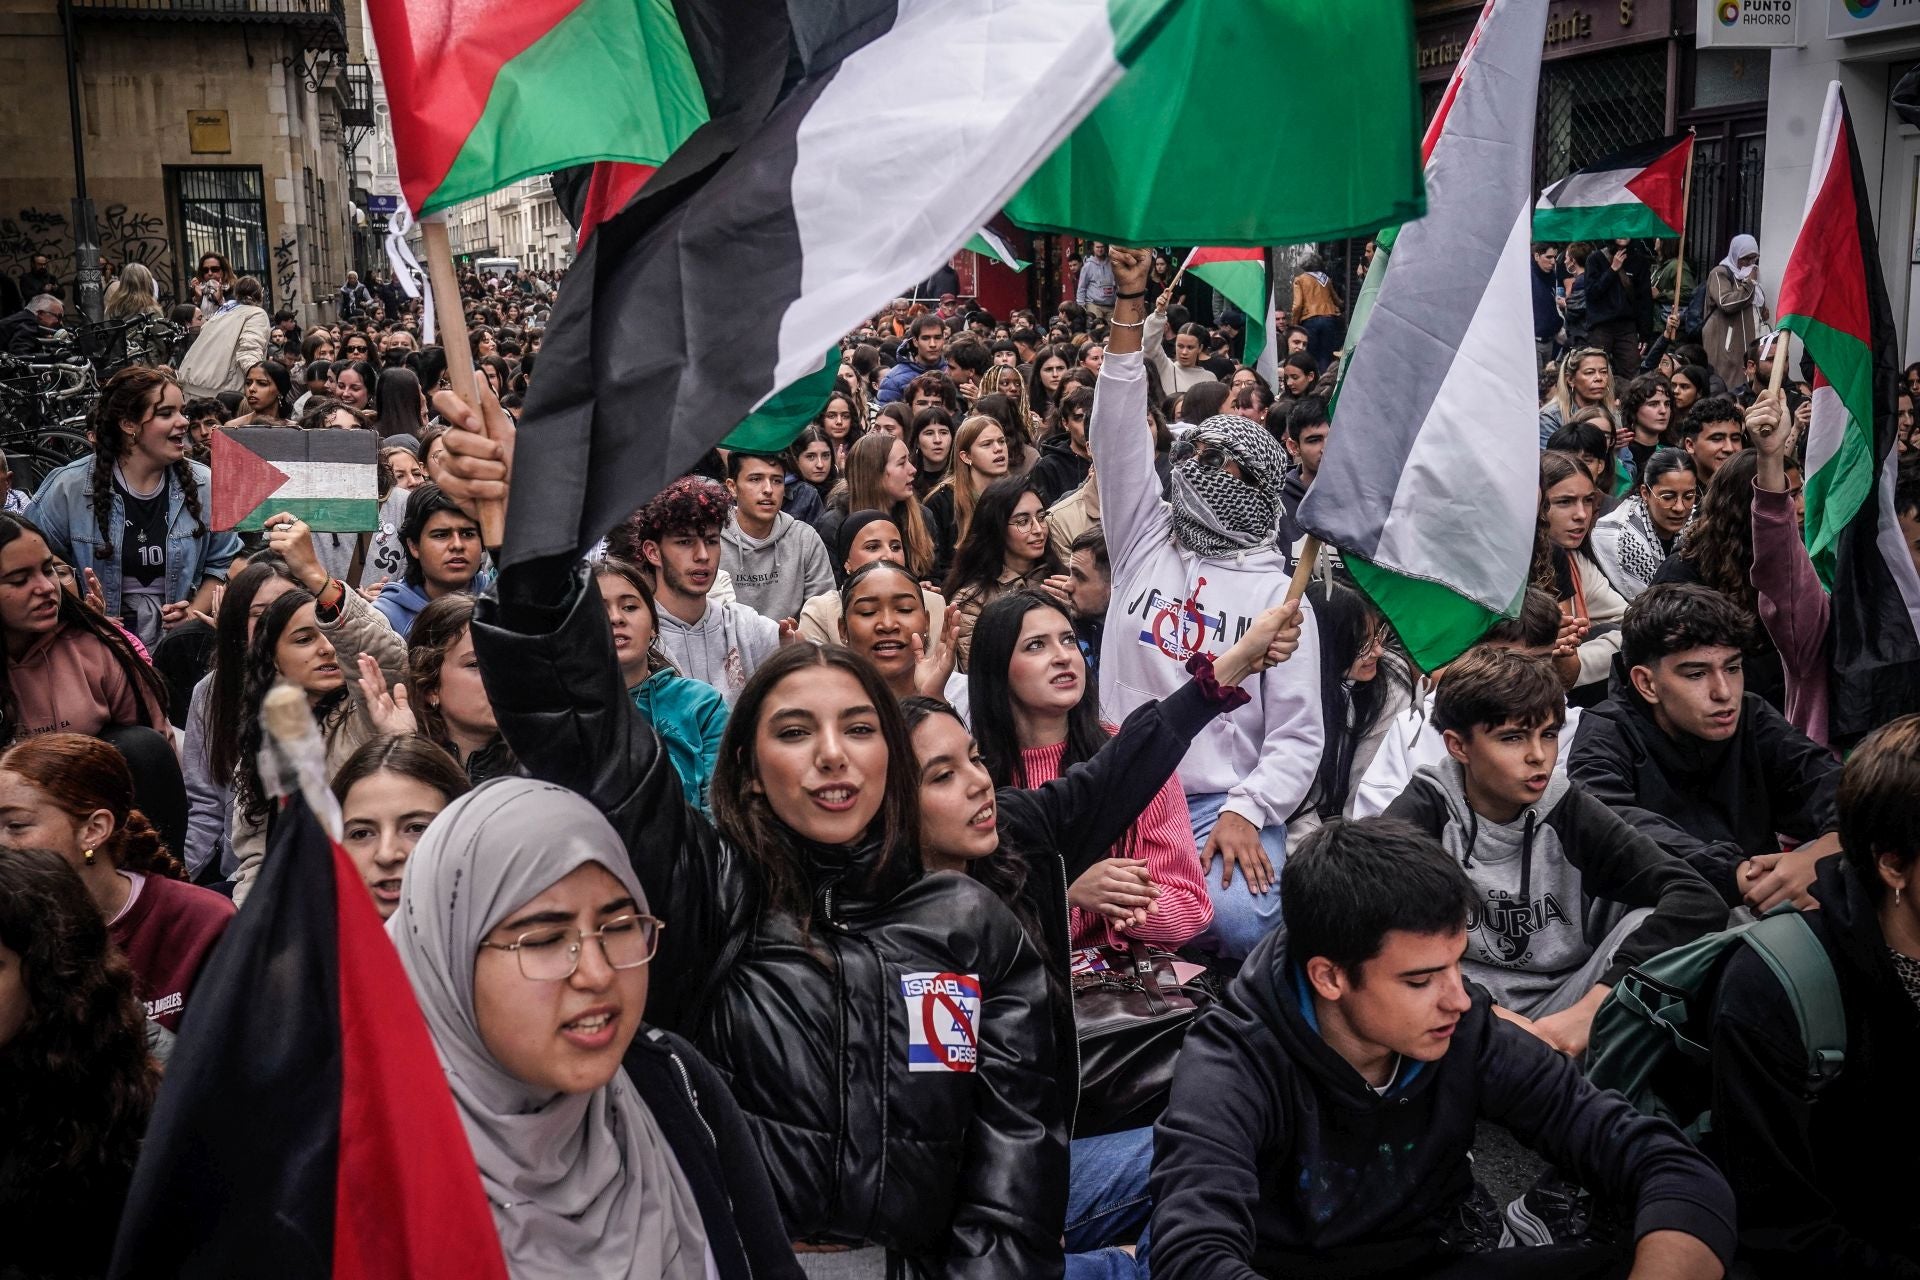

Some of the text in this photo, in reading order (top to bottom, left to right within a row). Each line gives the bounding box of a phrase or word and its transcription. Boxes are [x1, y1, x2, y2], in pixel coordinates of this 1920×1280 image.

[1743, 0, 1791, 11] PUNTO
[1743, 14, 1791, 25] AHORRO
[138, 545, 164, 566] 10
[1487, 889, 1512, 900] C.D.
[904, 979, 964, 996] ISRAEL
